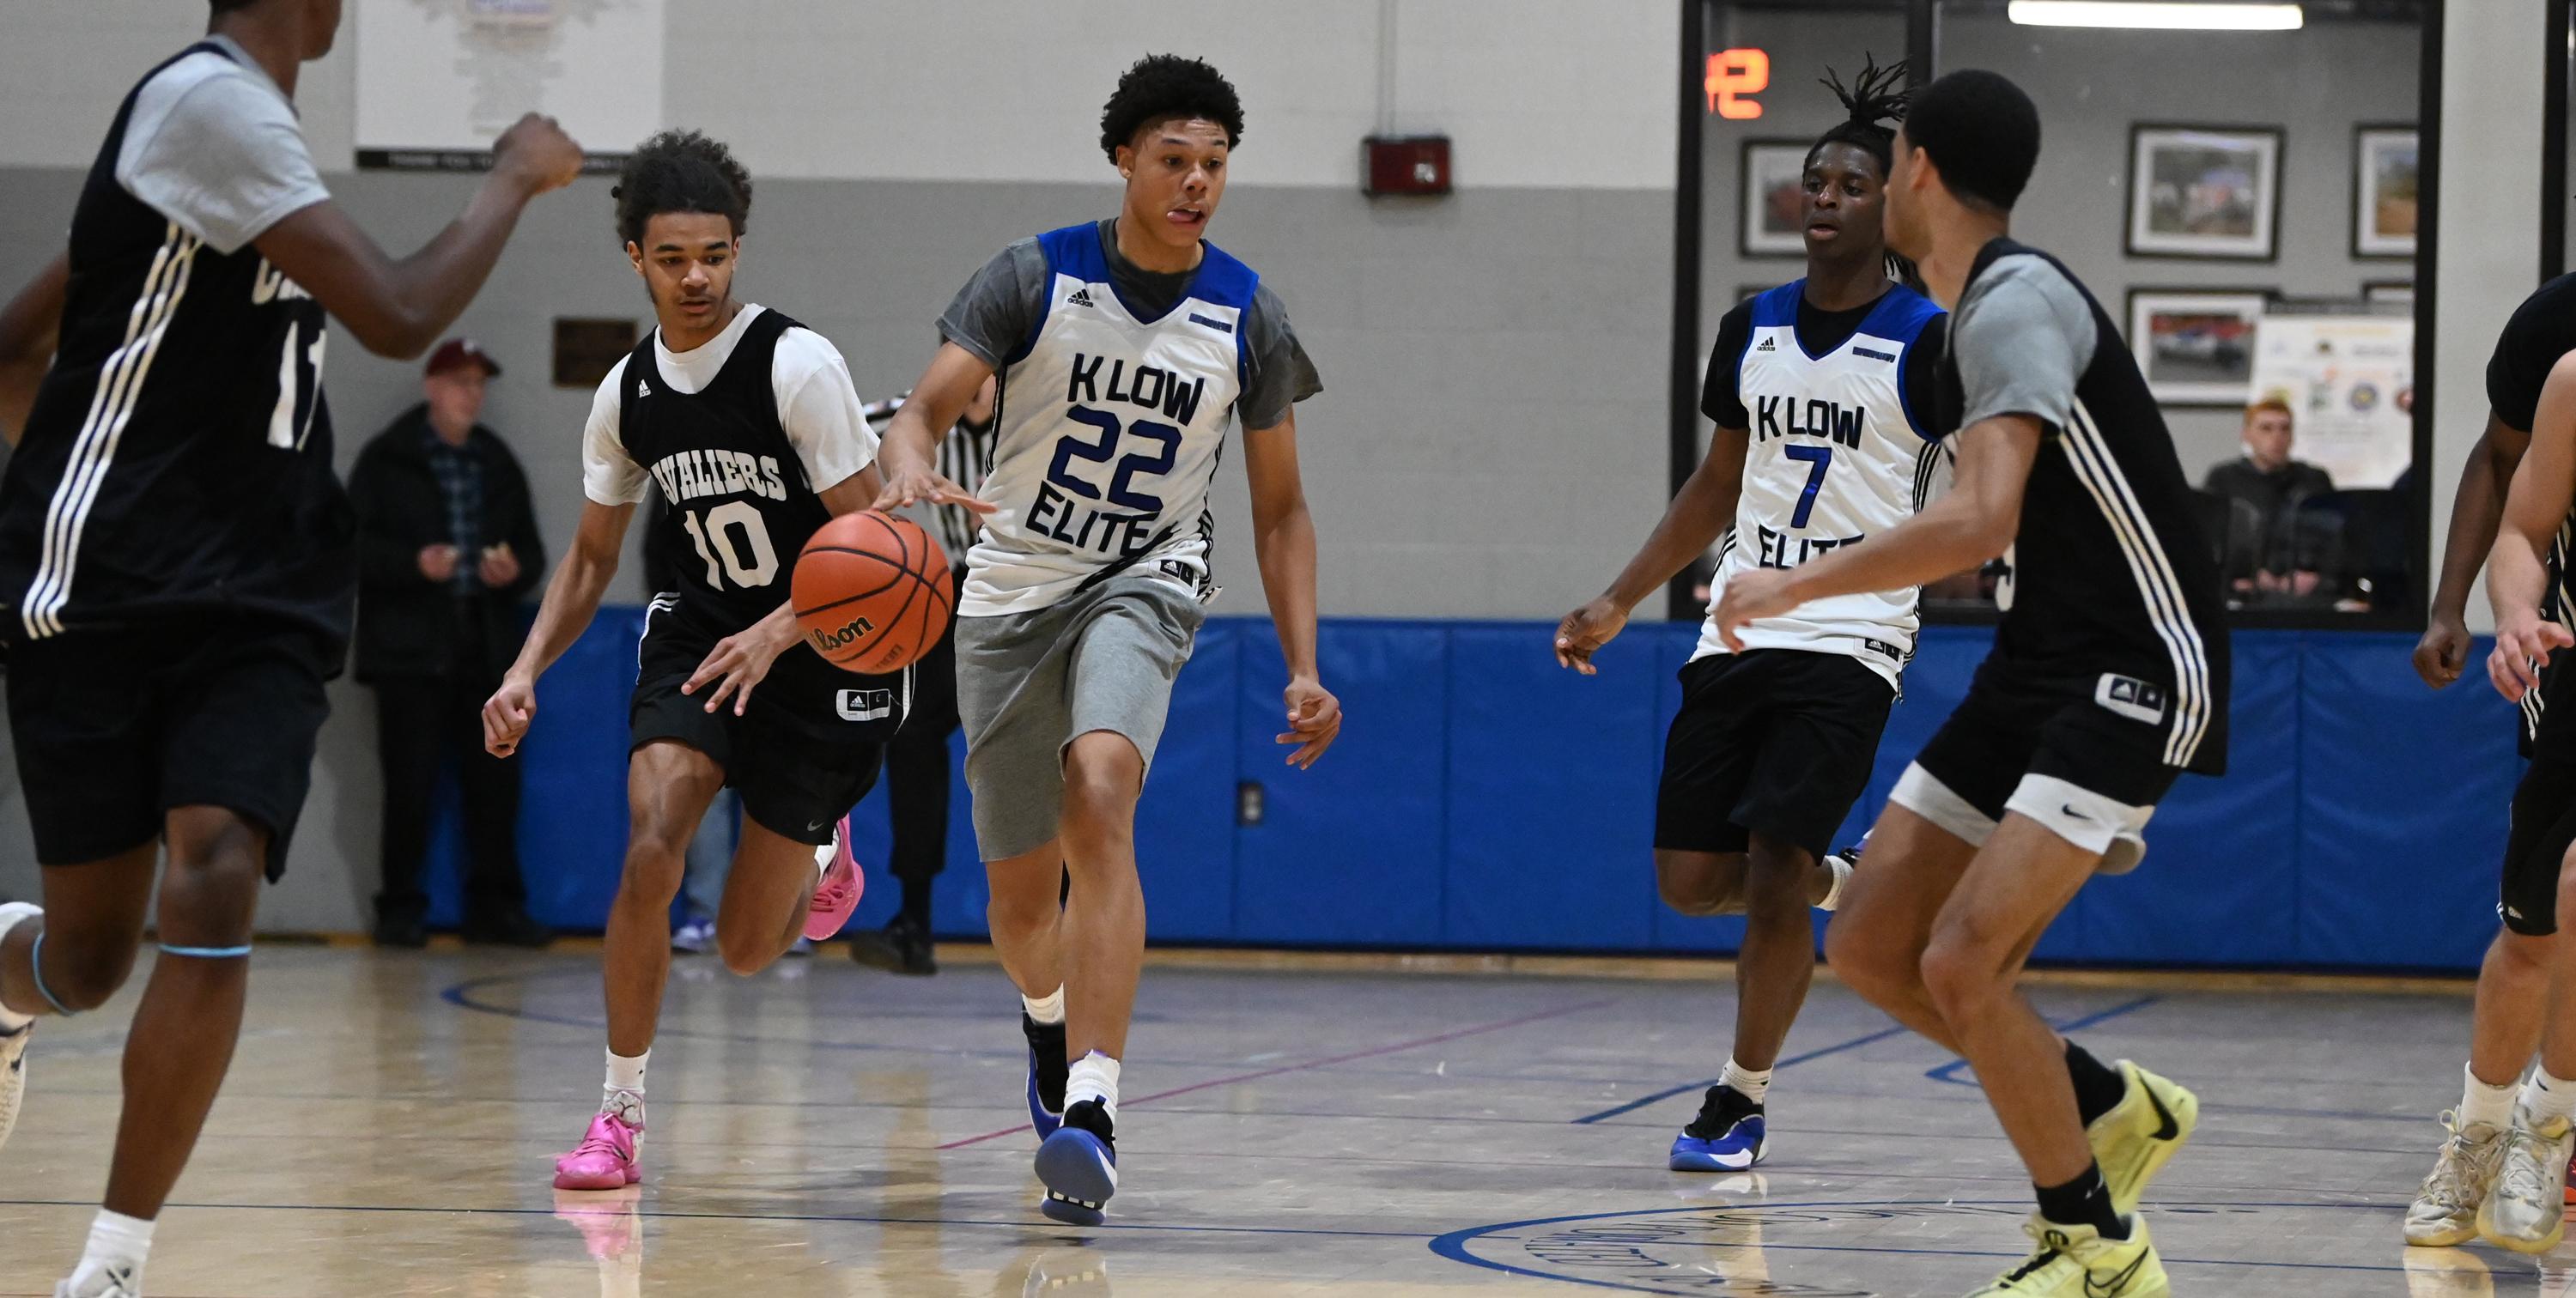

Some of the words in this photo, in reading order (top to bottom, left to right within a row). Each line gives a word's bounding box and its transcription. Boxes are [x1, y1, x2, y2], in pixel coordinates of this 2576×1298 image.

[1067, 298, 1094, 308] adidas
[650, 449, 787, 506] AVALIERS
[1047, 404, 1183, 513] 22
[1784, 444, 1832, 529] 7
[684, 500, 780, 591] 10
[1025, 480, 1161, 557] ELITE
[1759, 523, 1865, 570] ELIT
[809, 616, 874, 650] ilson
